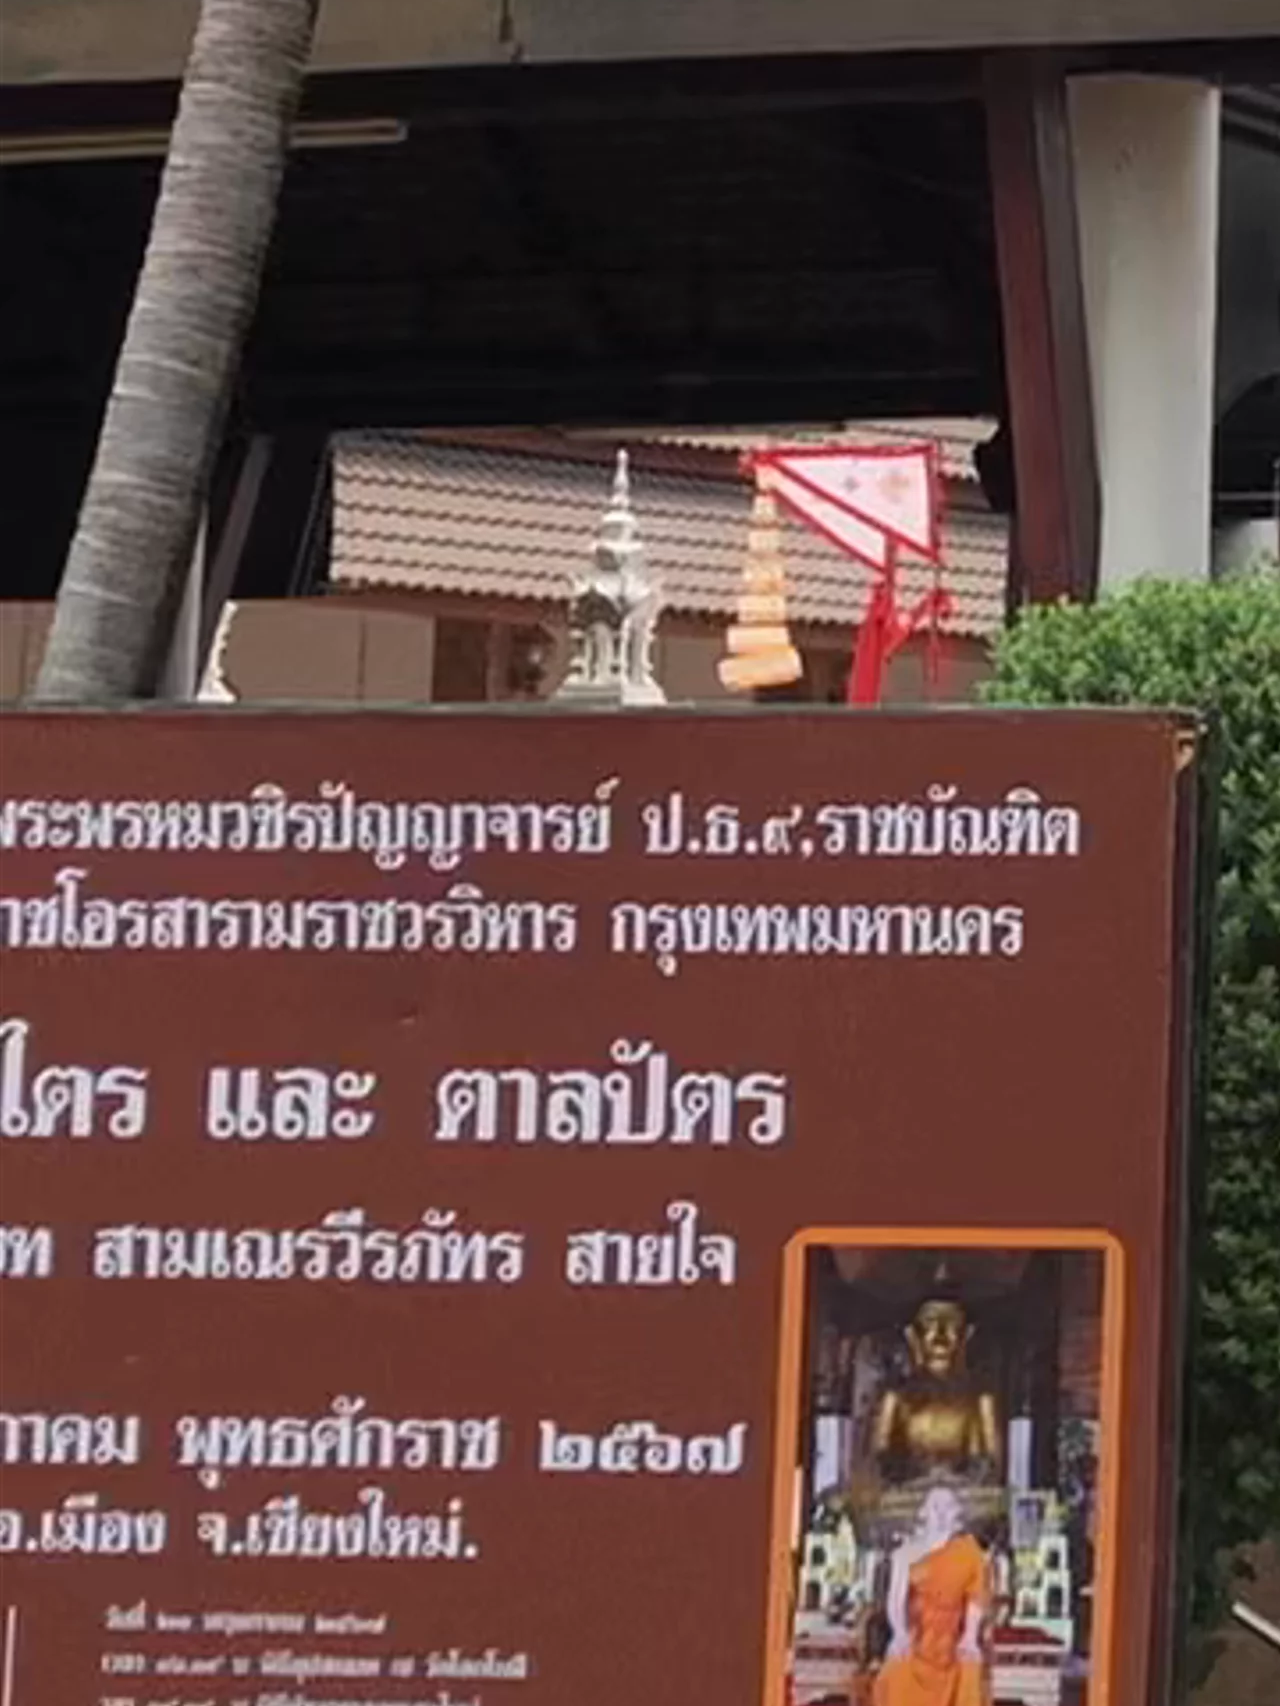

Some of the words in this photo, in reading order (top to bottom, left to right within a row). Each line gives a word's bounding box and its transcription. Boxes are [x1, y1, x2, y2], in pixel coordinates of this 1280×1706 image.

[612, 904, 1022, 975] กรุงเทพมหานคร
[208, 1068, 375, 1139] และ
[435, 1039, 785, 1143] ตาลปัตร
[95, 1208, 523, 1282] สามเณรวีรภัทร
[567, 1201, 735, 1284] สายใจ
[177, 1396, 499, 1488] พุทธศักราช
[540, 1421, 746, 1473] ๒๕๖๗
